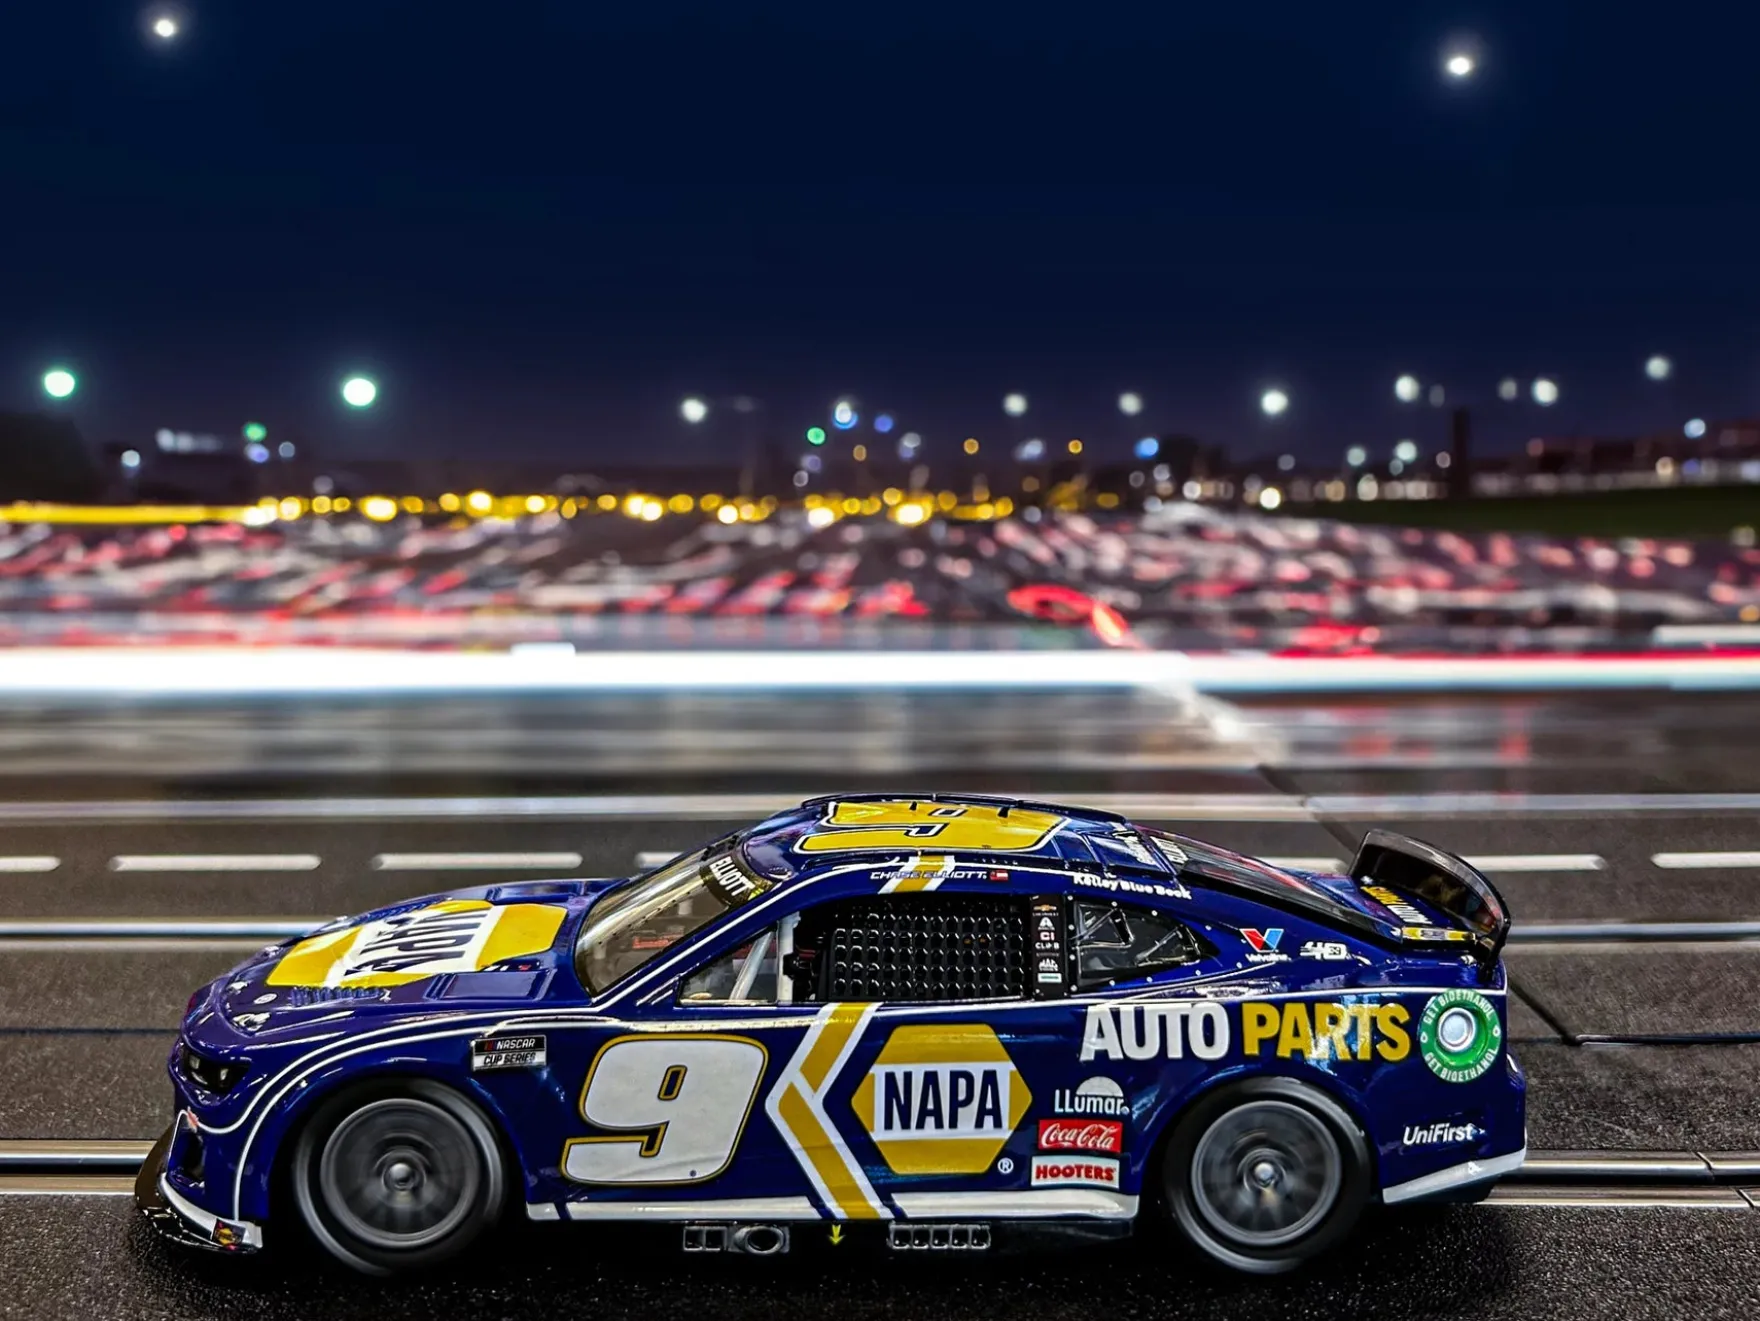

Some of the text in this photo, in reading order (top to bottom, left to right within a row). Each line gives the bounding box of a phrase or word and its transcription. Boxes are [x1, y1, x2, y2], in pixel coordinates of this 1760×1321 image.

[709, 855, 756, 897] ELLIOTT
[870, 871, 986, 880] CHASE ELLIOTT
[1120, 880, 1153, 893] Blue
[1153, 885, 1192, 900] Book
[1422, 988, 1494, 1025] GET BIOETHANOL
[496, 1038, 535, 1050] NASCAR
[1079, 1001, 1411, 1061] AUTO PARTS
[483, 1052, 536, 1067] CUP SERIES
[1424, 1048, 1498, 1082] GET BIOETHANOL
[560, 1032, 769, 1186] 9
[884, 1069, 1003, 1131] NAPA
[1403, 1122, 1473, 1145] UniFirst
[1036, 1164, 1115, 1181] HOOTERS
